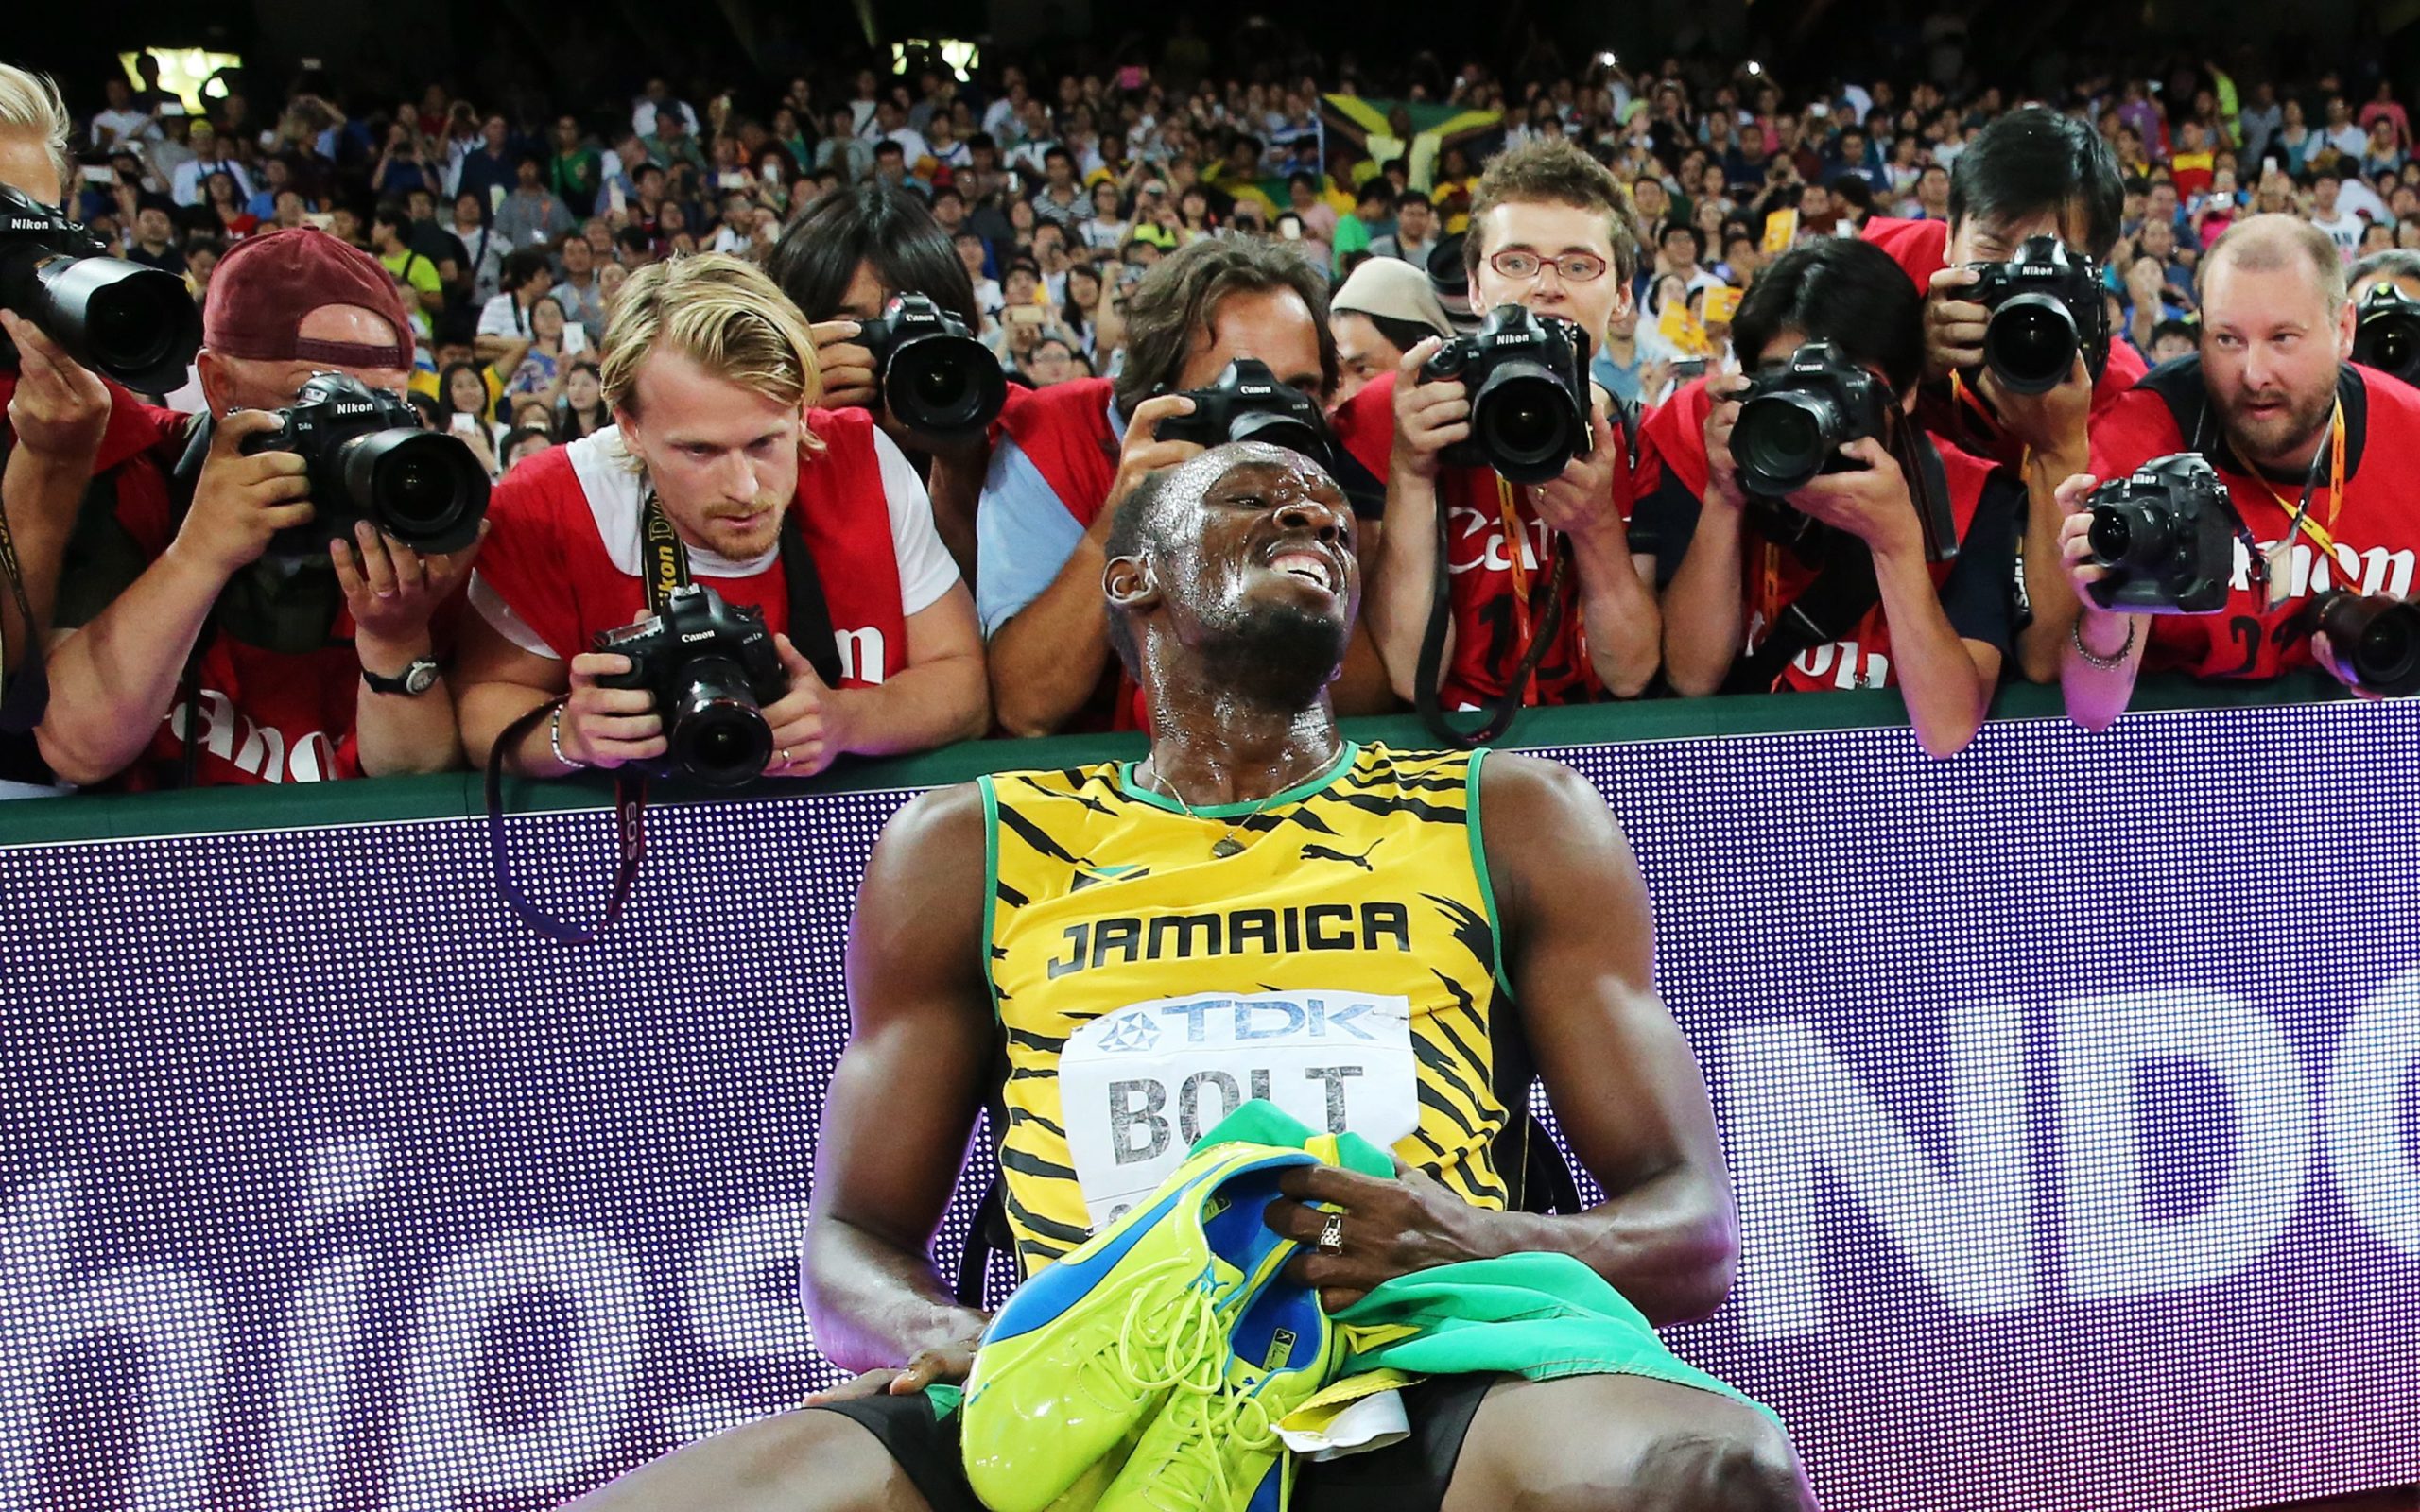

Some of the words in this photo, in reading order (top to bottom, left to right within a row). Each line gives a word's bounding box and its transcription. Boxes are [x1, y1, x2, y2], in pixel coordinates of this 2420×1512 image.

[11, 218, 49, 230] Nikon
[2022, 266, 2054, 276] Nikon
[1496, 334, 1530, 345] Nikon
[1794, 363, 1824, 371] Canon
[1240, 386, 1271, 394] Canon
[337, 403, 373, 414] Nikon
[681, 629, 716, 643] Canon
[1047, 902, 1411, 980] JAMAICA
[1161, 998, 1380, 1043] TDK
